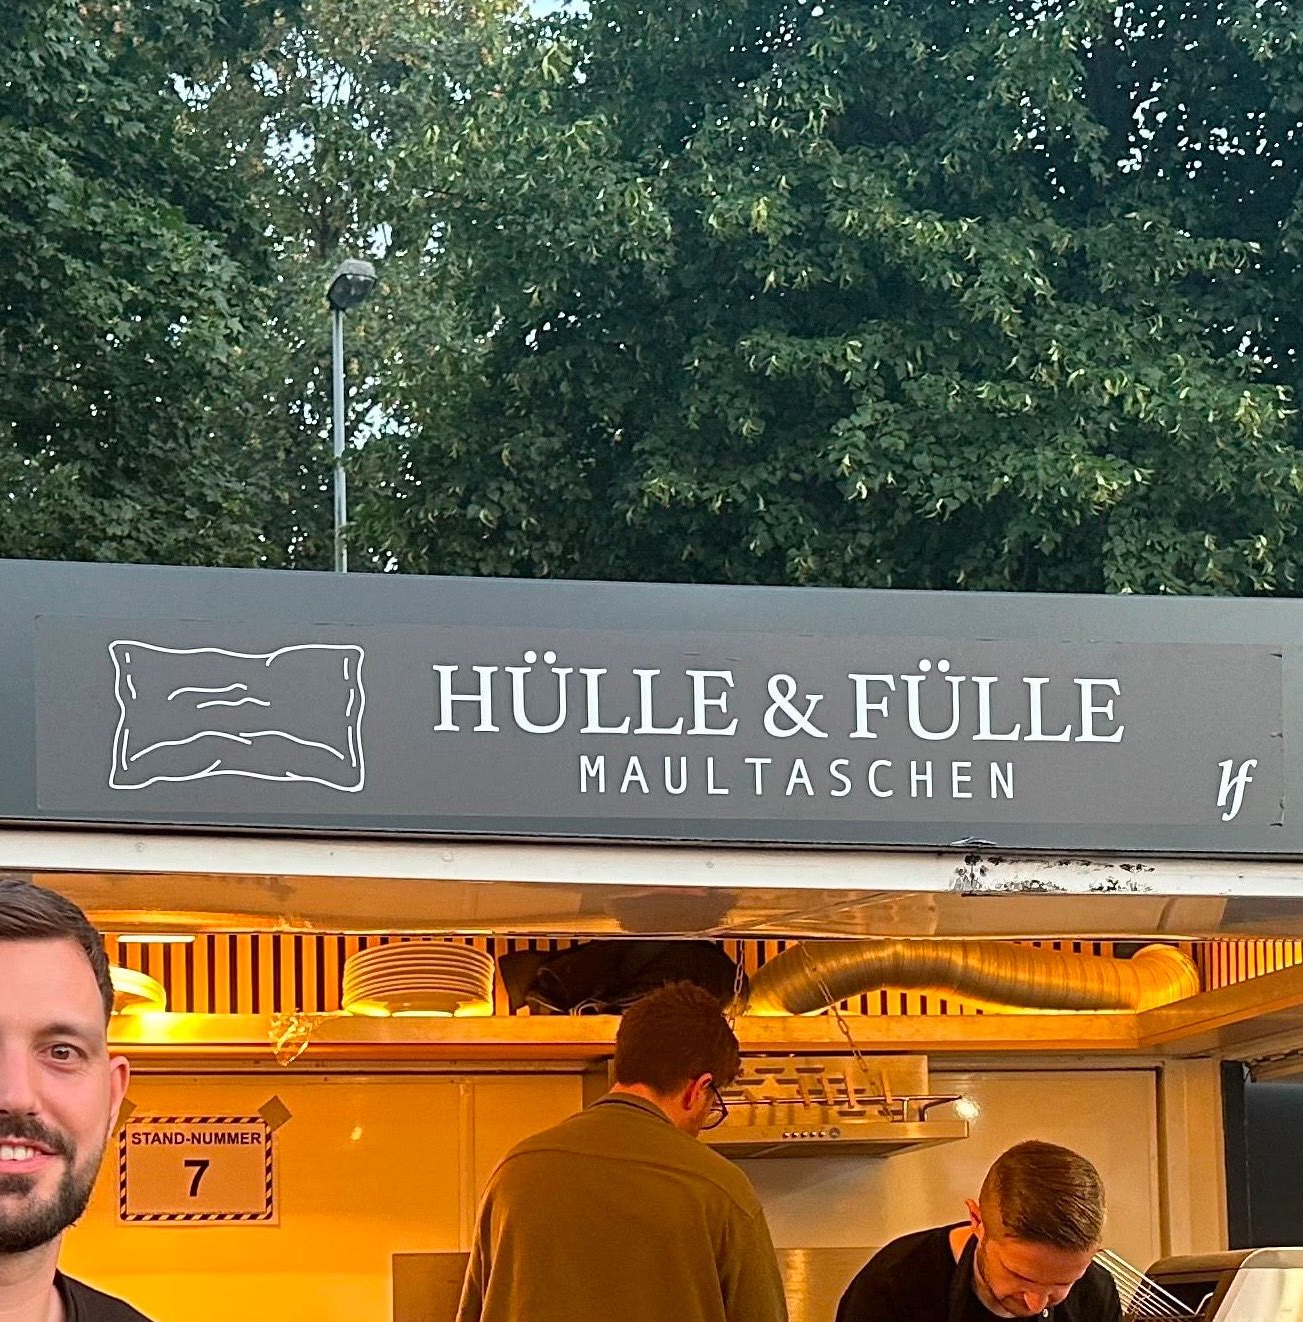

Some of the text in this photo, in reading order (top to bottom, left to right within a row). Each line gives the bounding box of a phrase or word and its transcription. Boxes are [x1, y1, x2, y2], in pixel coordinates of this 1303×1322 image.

[432, 650, 1126, 744] HÜLLE & FÜLLE
[580, 754, 1016, 800] MAULTASCHEN
[131, 1131, 262, 1145] STAND-NUMMER
[184, 1159, 210, 1197] 7
